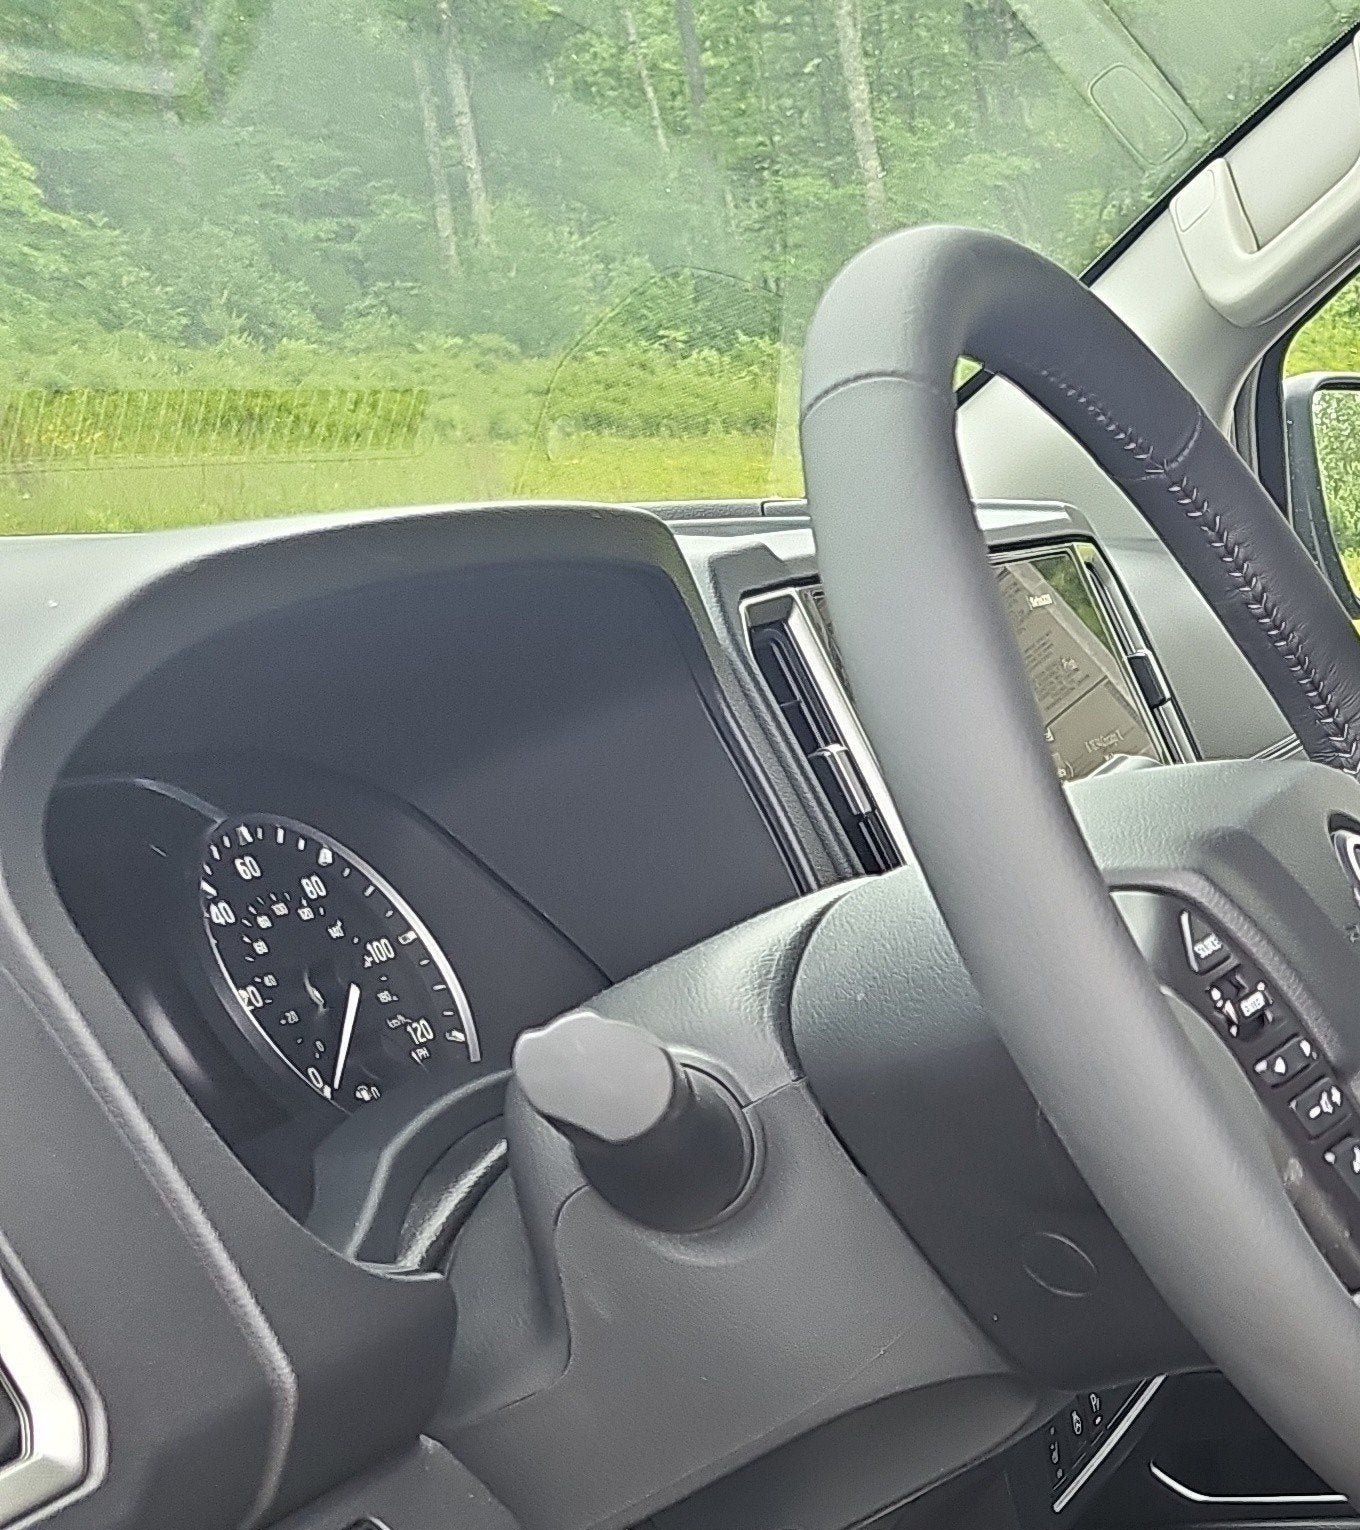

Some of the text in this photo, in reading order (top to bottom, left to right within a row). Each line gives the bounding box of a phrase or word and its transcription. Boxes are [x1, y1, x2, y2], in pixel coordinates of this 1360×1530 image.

[234, 855, 261, 880] 60
[300, 874, 327, 899] 80
[209, 900, 236, 926] 40
[366, 938, 395, 964] 100
[406, 1018, 434, 1045] 120
[307, 1066, 324, 1089] 0
